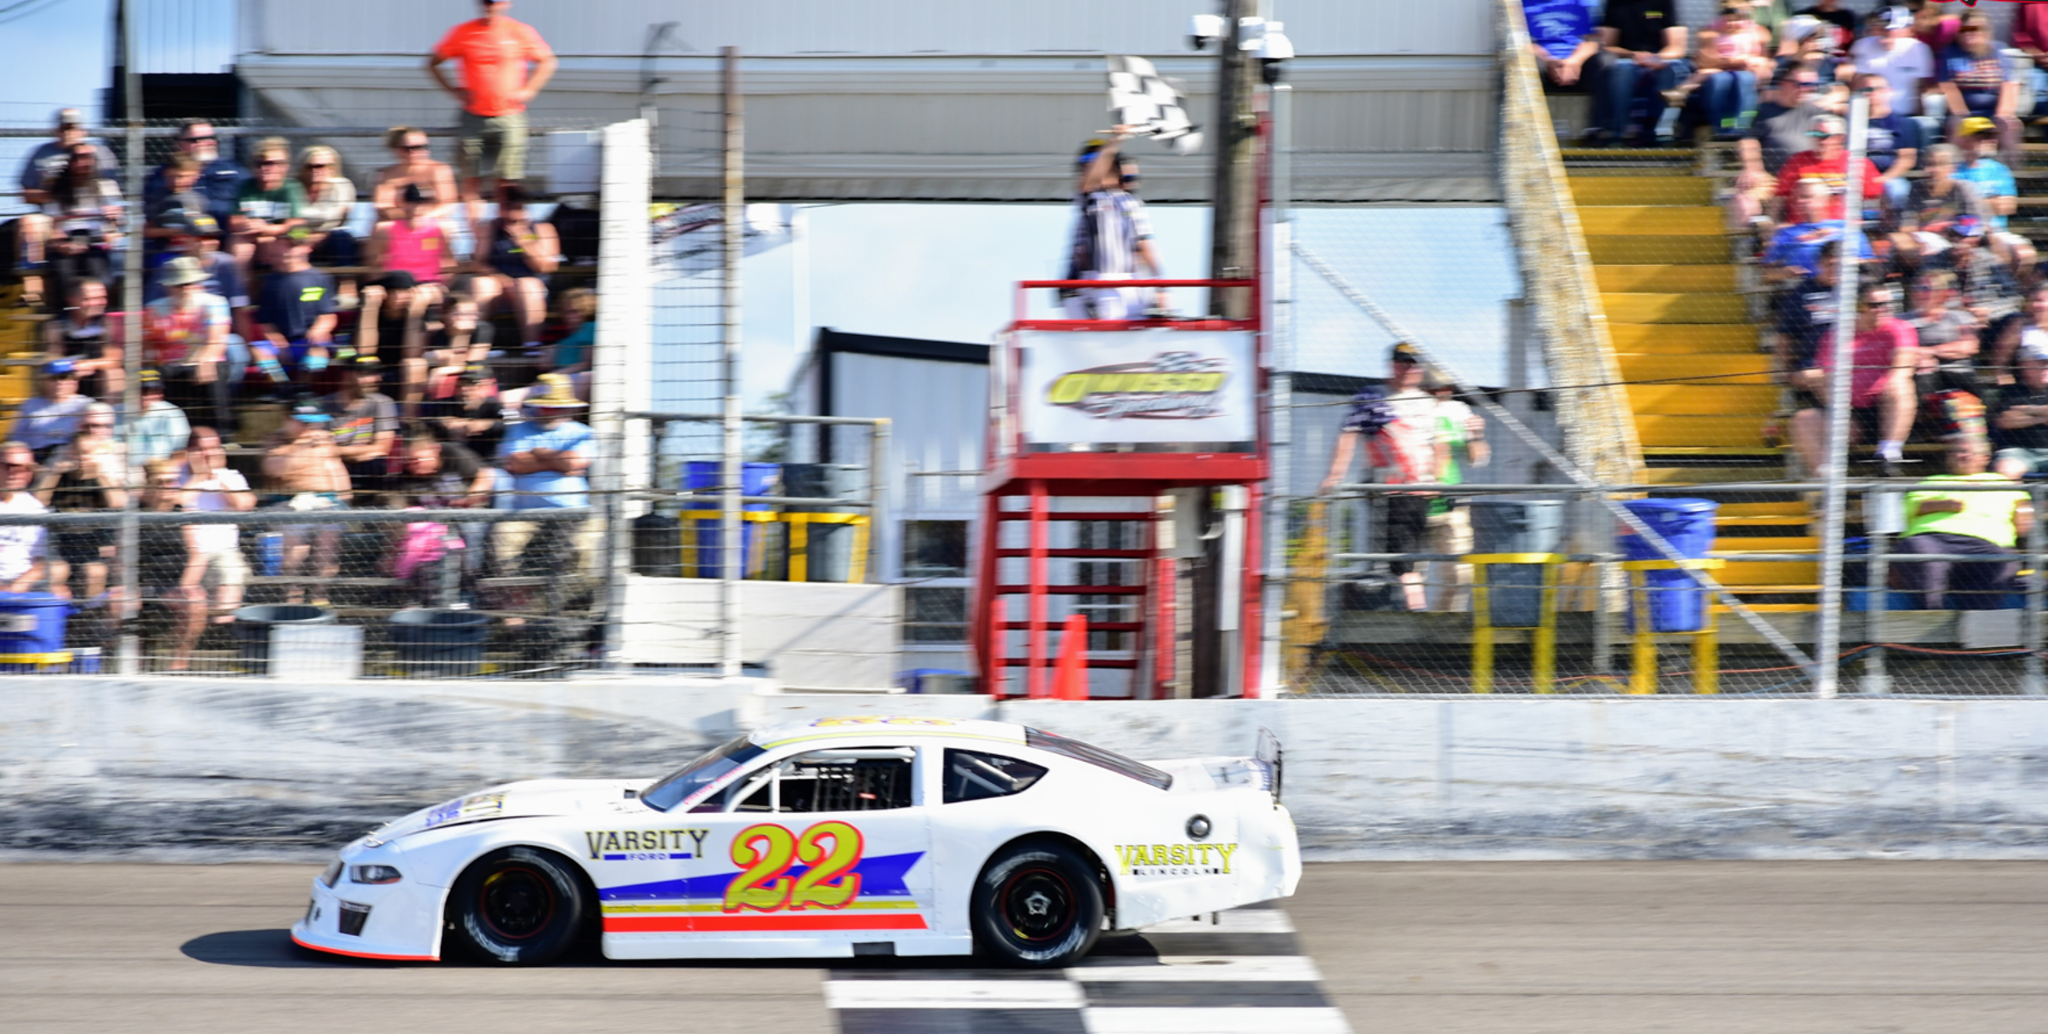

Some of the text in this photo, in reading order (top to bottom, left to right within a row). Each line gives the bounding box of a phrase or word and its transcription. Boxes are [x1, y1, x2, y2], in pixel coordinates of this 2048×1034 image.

[585, 829, 710, 860] VARSITY
[629, 853, 668, 861] FORD
[1114, 843, 1238, 875] VARSITY
[722, 820, 865, 914] 22
